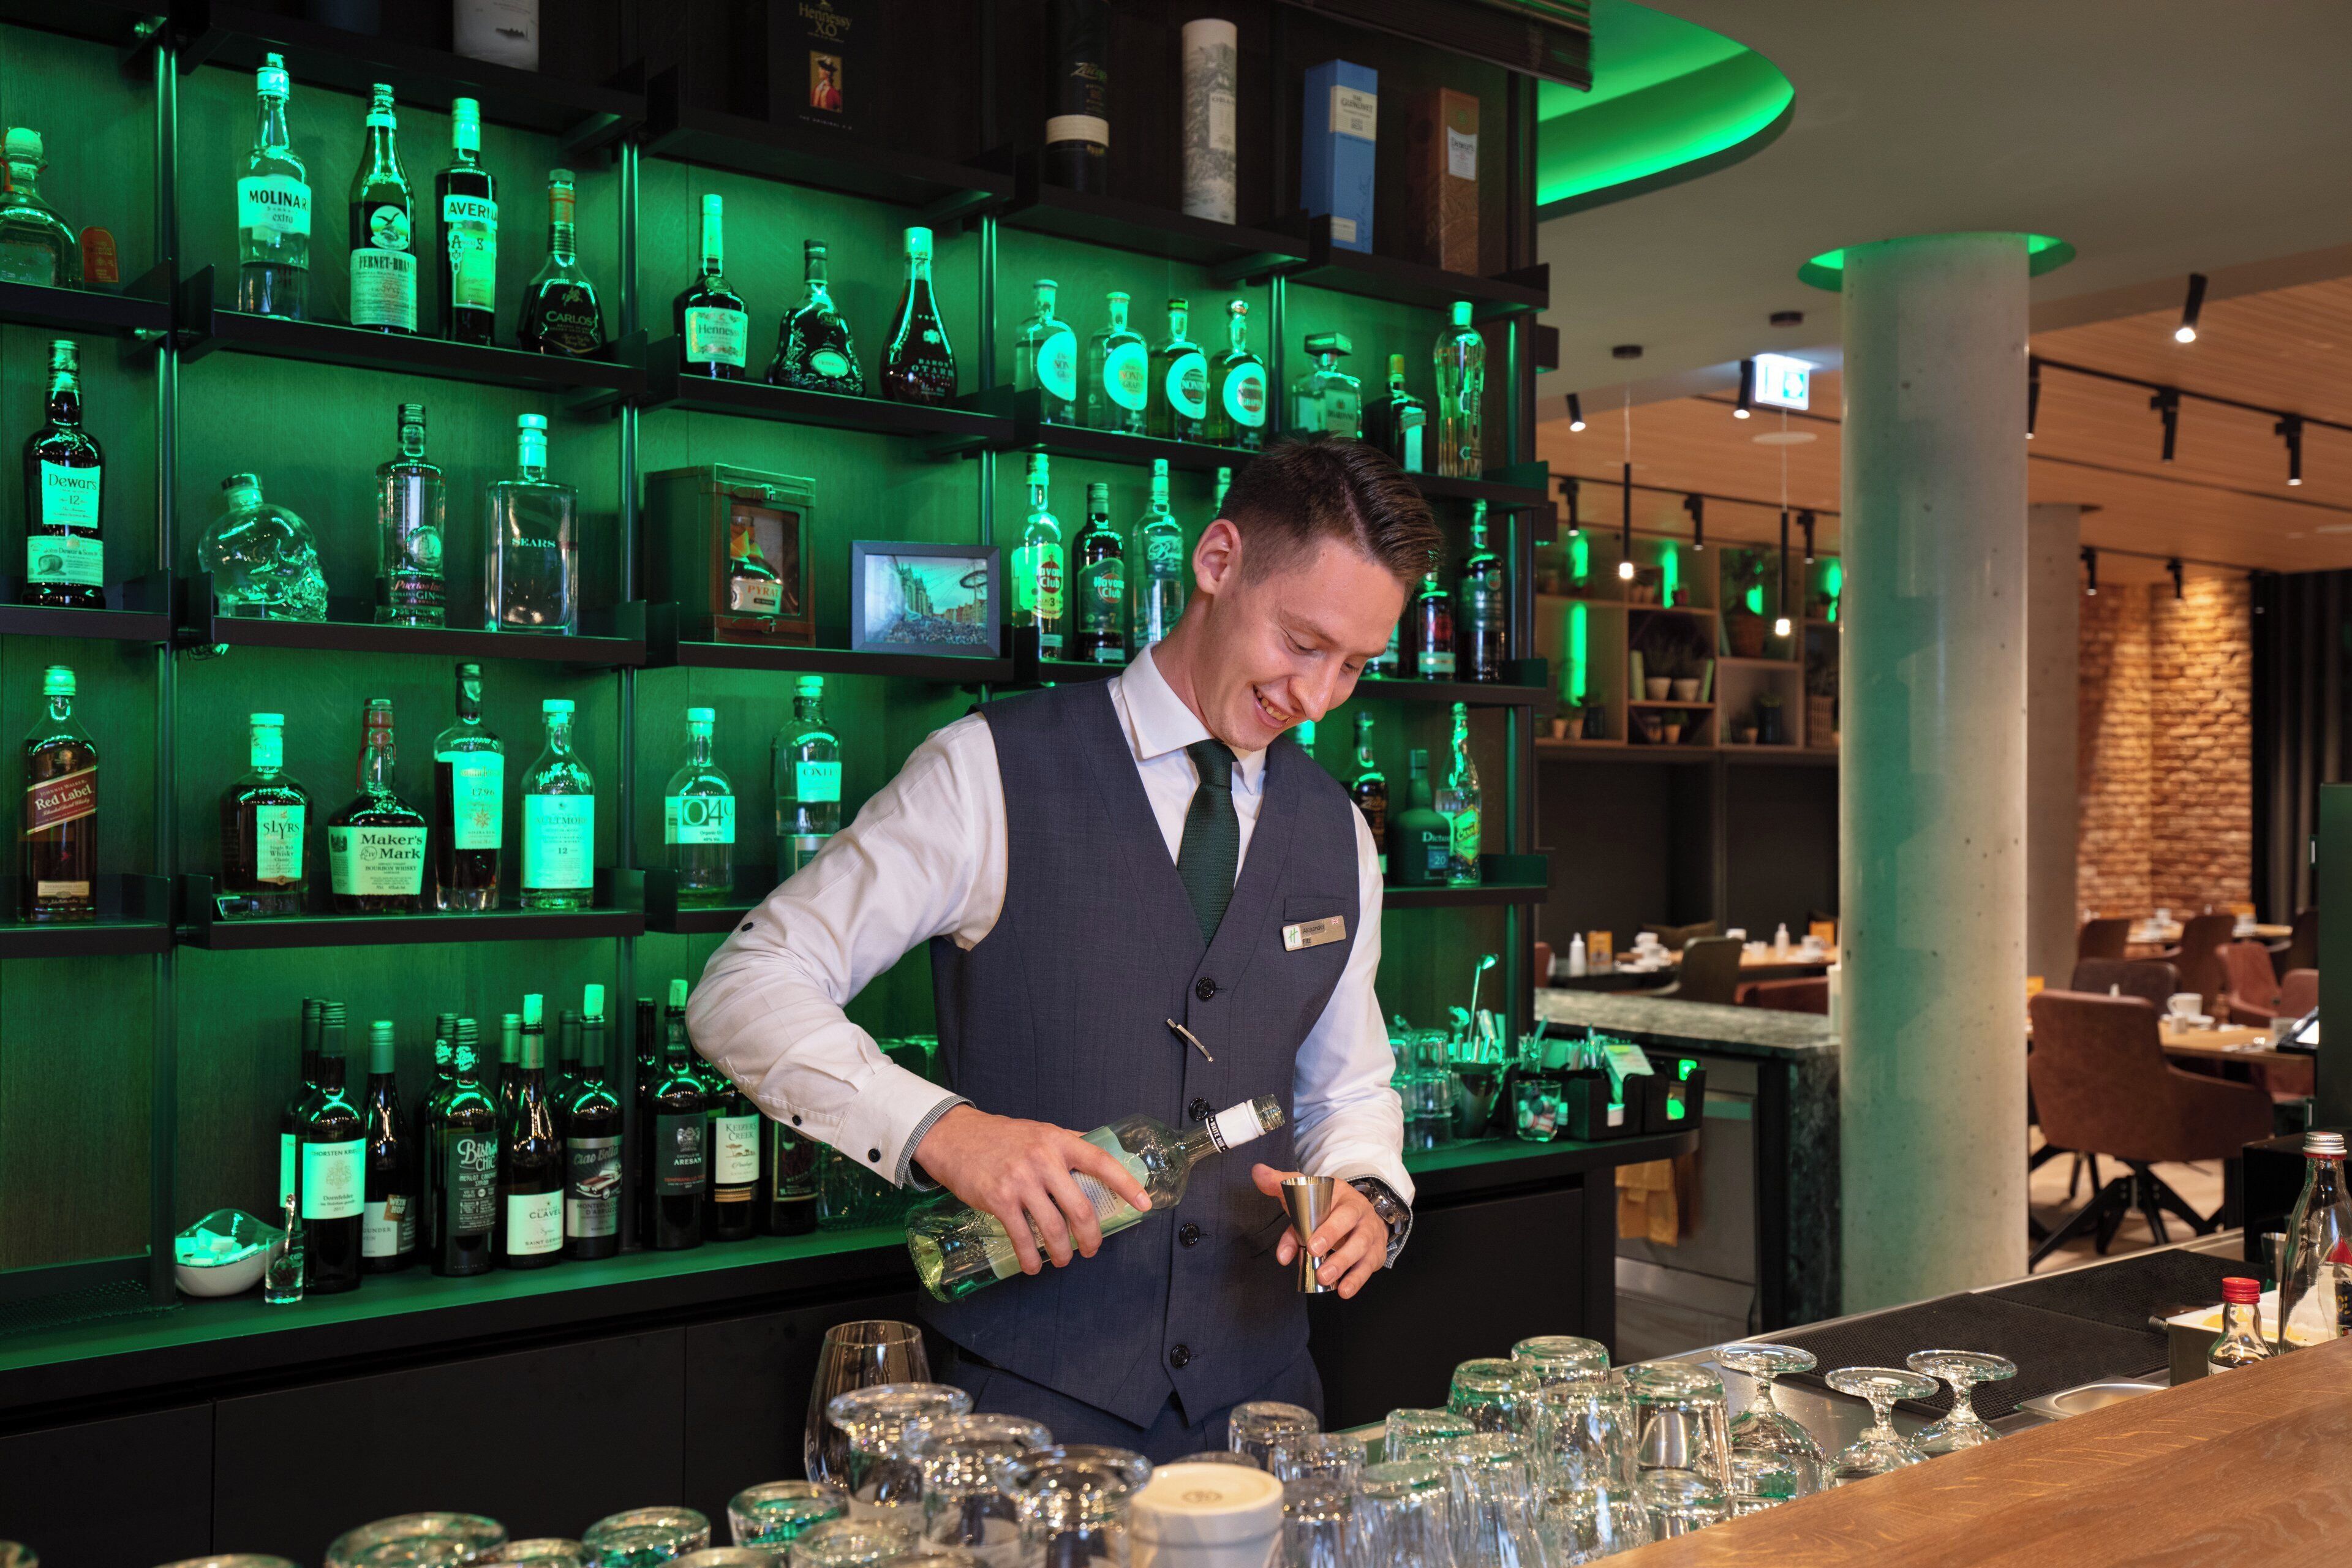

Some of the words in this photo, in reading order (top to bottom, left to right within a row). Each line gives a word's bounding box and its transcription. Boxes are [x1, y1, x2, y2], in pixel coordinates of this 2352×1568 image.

[799, 2, 852, 30] Hennessy
[49, 473, 97, 491] Dewar's
[70, 495, 80, 505] 12
[511, 538, 556, 548] SEARS
[1040, 577, 1060, 588] Club
[1094, 576, 1125, 589] Havana
[417, 590, 435, 600] GIN
[1102, 587, 1121, 598] Club
[35, 794, 60, 810] Red
[61, 784, 92, 802] Label
[263, 820, 300, 840] SLYRS
[360, 834, 423, 845] Maker's
[270, 850, 294, 859] Whisky
[380, 848, 421, 859] Mark
[1433, 856, 1446, 865] 20
[1303, 924, 1325, 934] Alexander
[728, 1131, 755, 1141] CREEK
[1210, 1121, 1220, 1138] WHITE
[1216, 1137, 1225, 1147] RUM
[674, 1157, 702, 1166] ARESAN
[529, 1209, 561, 1219] CLAVEL
